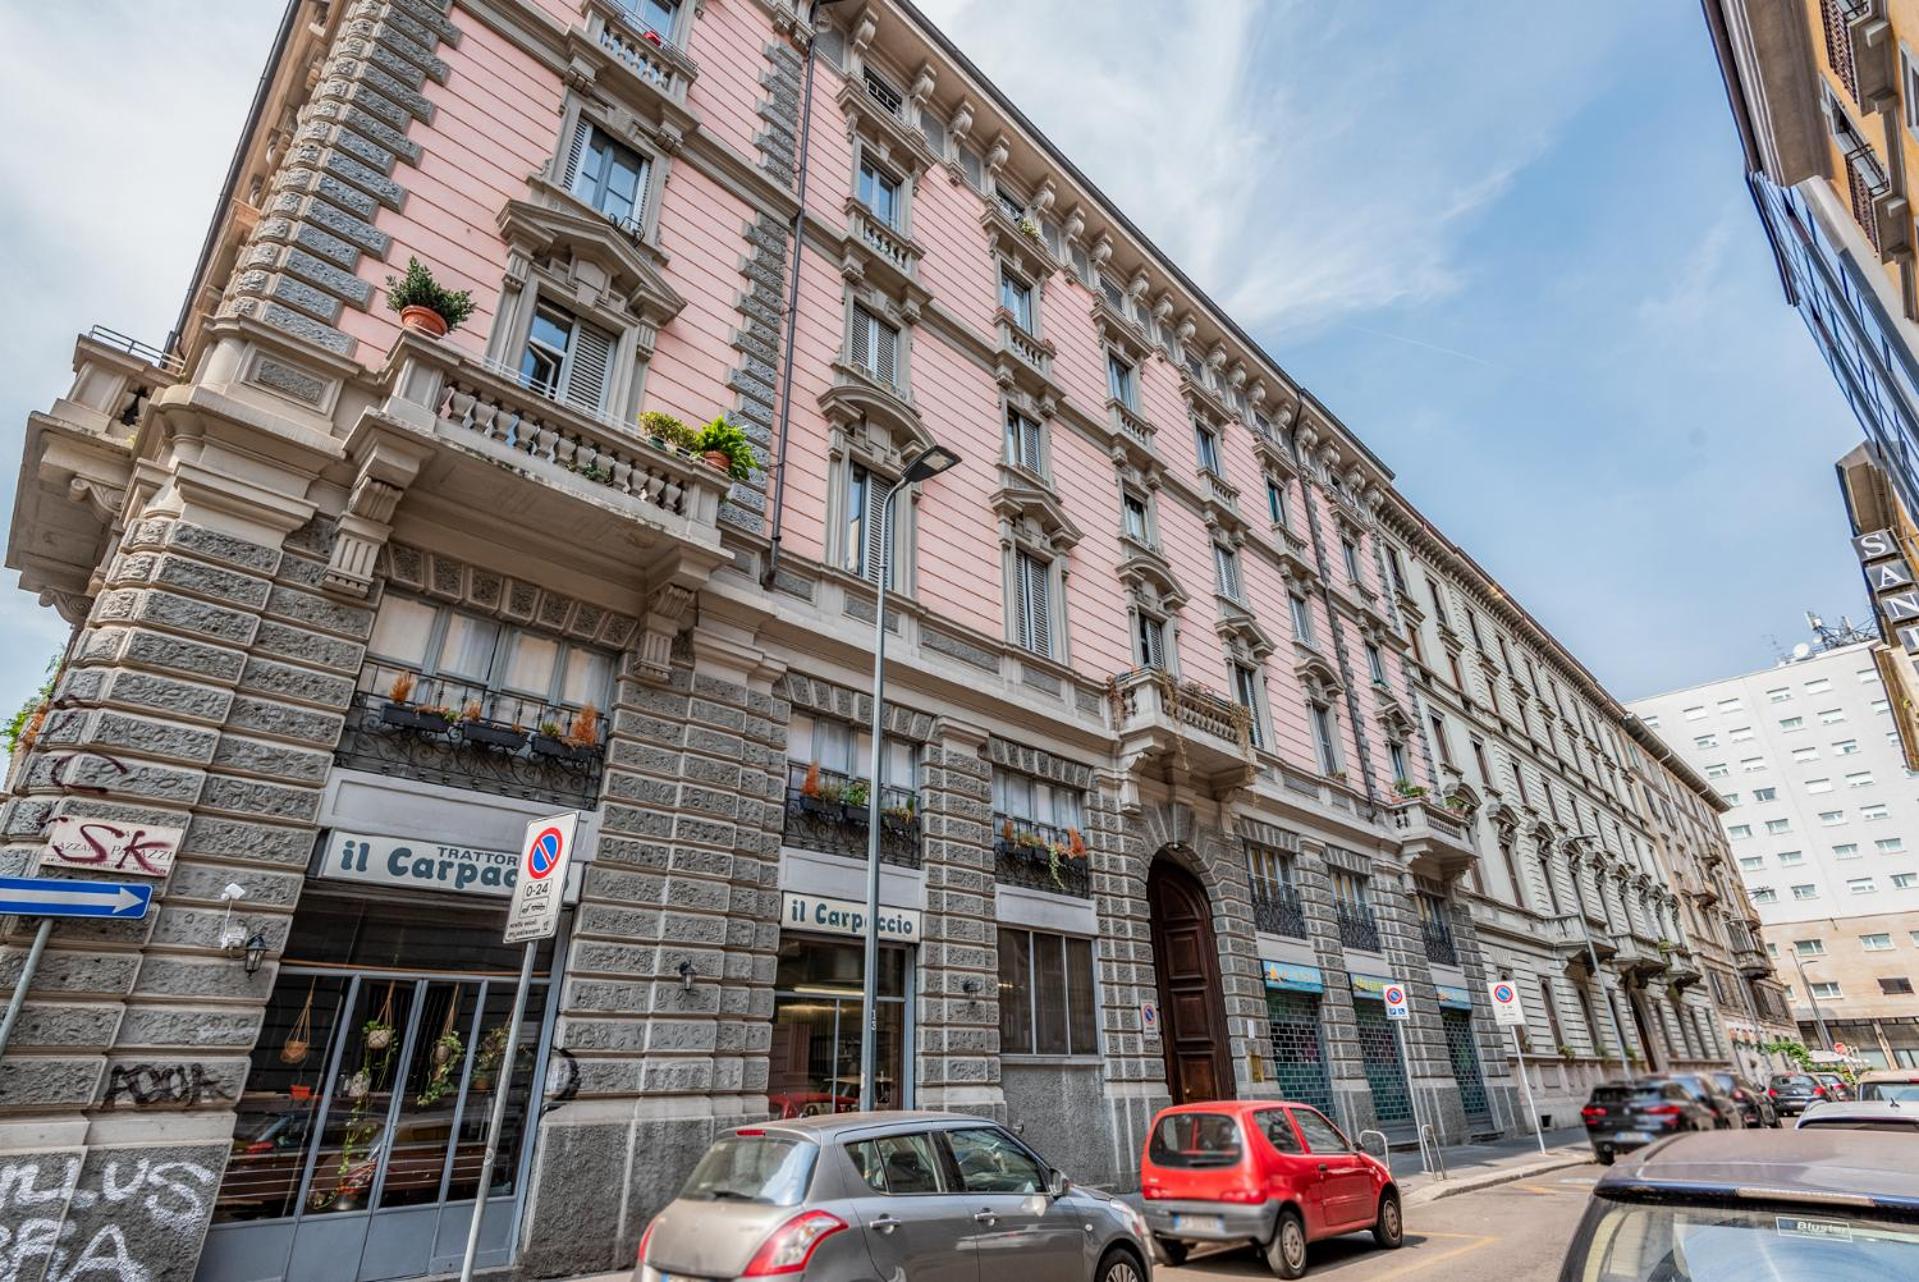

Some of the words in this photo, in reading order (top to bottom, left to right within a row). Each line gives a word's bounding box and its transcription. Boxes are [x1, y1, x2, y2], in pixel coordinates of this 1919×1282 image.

[340, 840, 371, 872] il
[387, 847, 518, 890] Carpac
[438, 846, 518, 866] TRATTOR
[526, 882, 549, 897] 0-24
[791, 898, 806, 922] il
[815, 902, 913, 935] Carpccio
